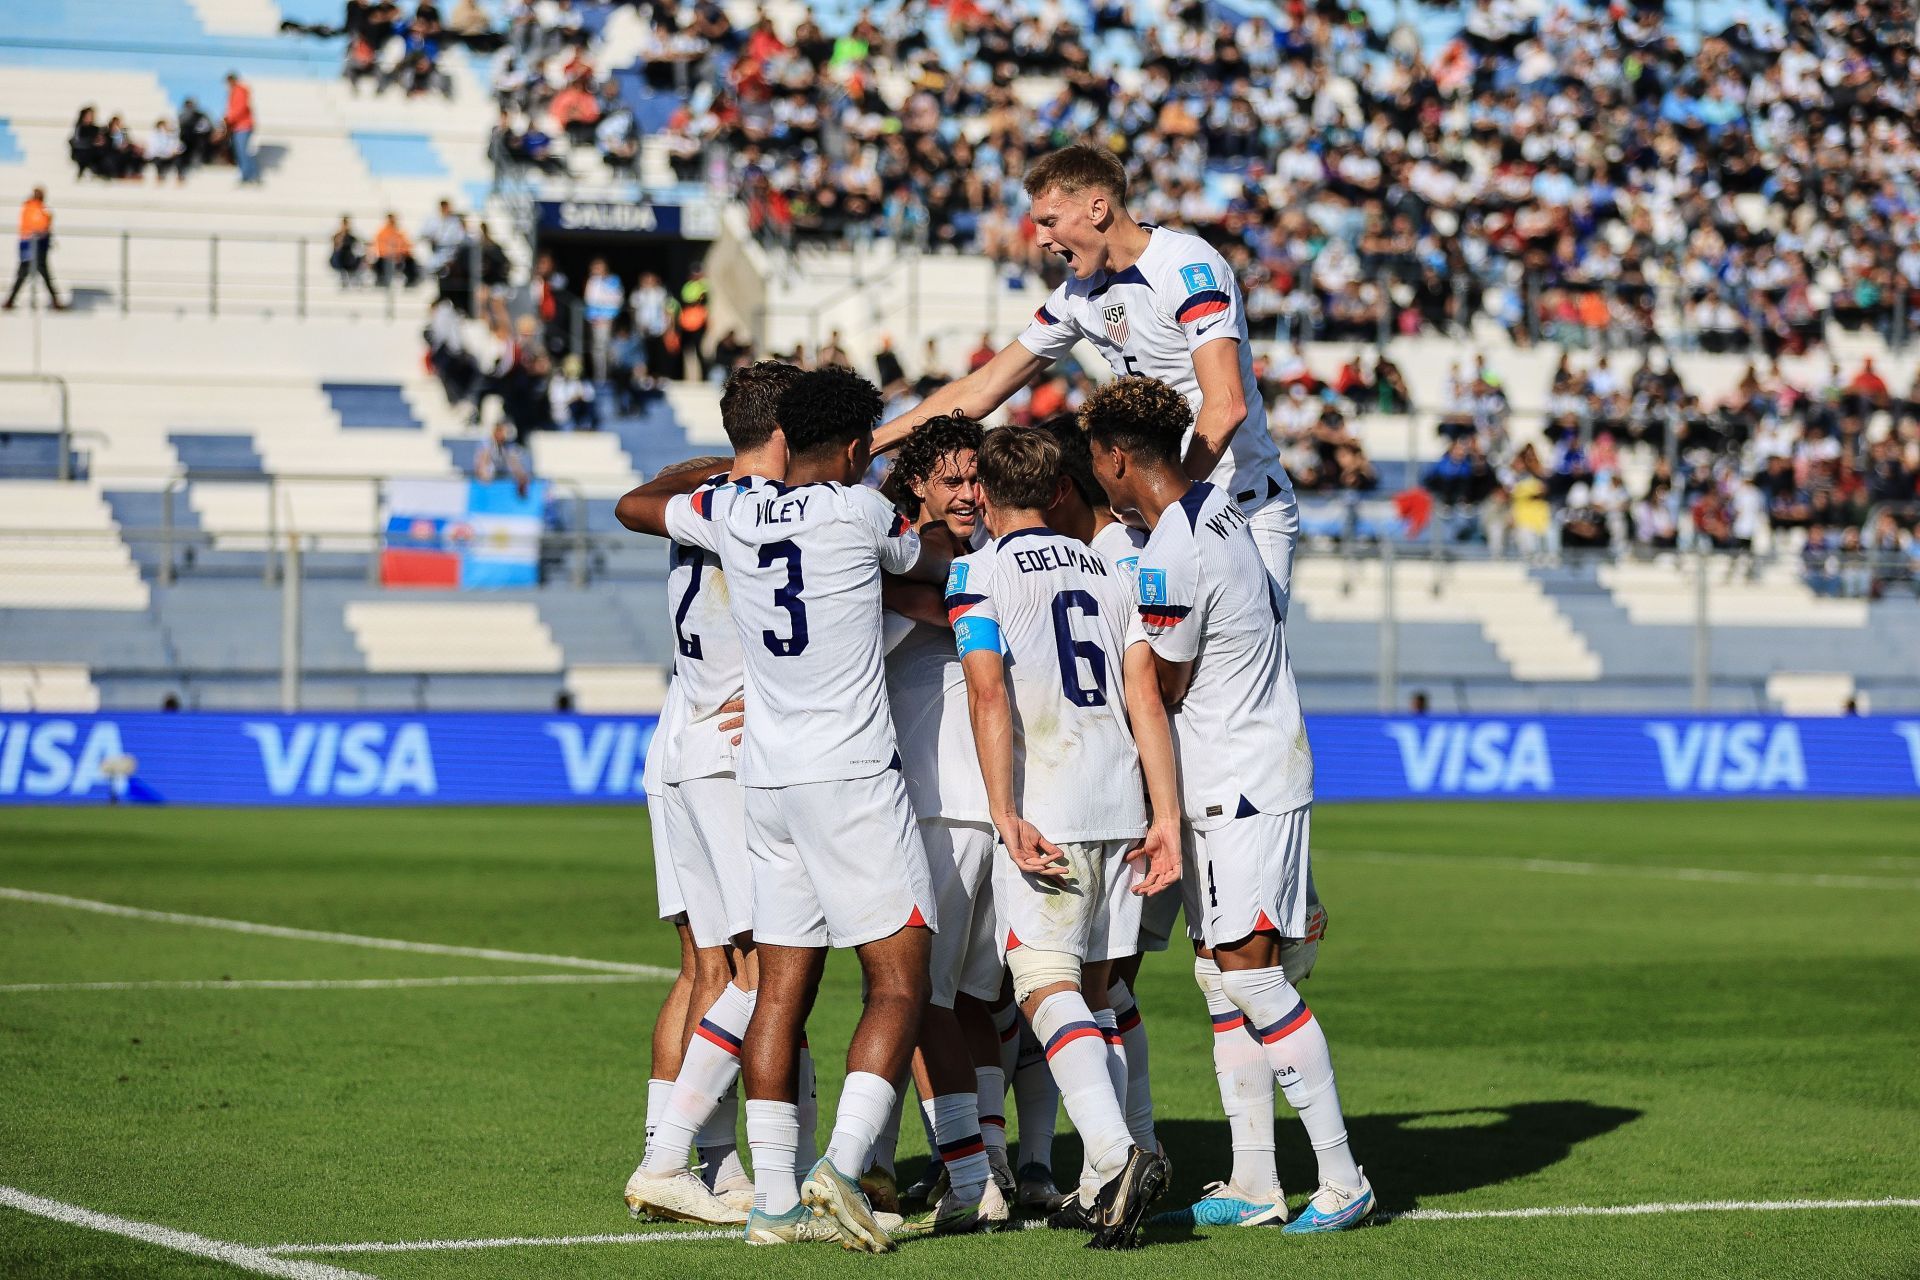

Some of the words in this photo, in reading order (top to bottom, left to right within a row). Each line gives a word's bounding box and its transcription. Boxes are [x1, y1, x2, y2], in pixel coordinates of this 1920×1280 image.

[559, 202, 657, 231] SALIDA
[1104, 306, 1125, 323] USA
[1013, 545, 1107, 576] EDELMAN
[676, 546, 703, 660] 2
[758, 539, 809, 656] 3
[1052, 590, 1107, 707] 6
[0, 719, 130, 795] ISA
[244, 721, 437, 795] VISA
[1384, 720, 1555, 792] VISA
[1643, 720, 1807, 792] VISA
